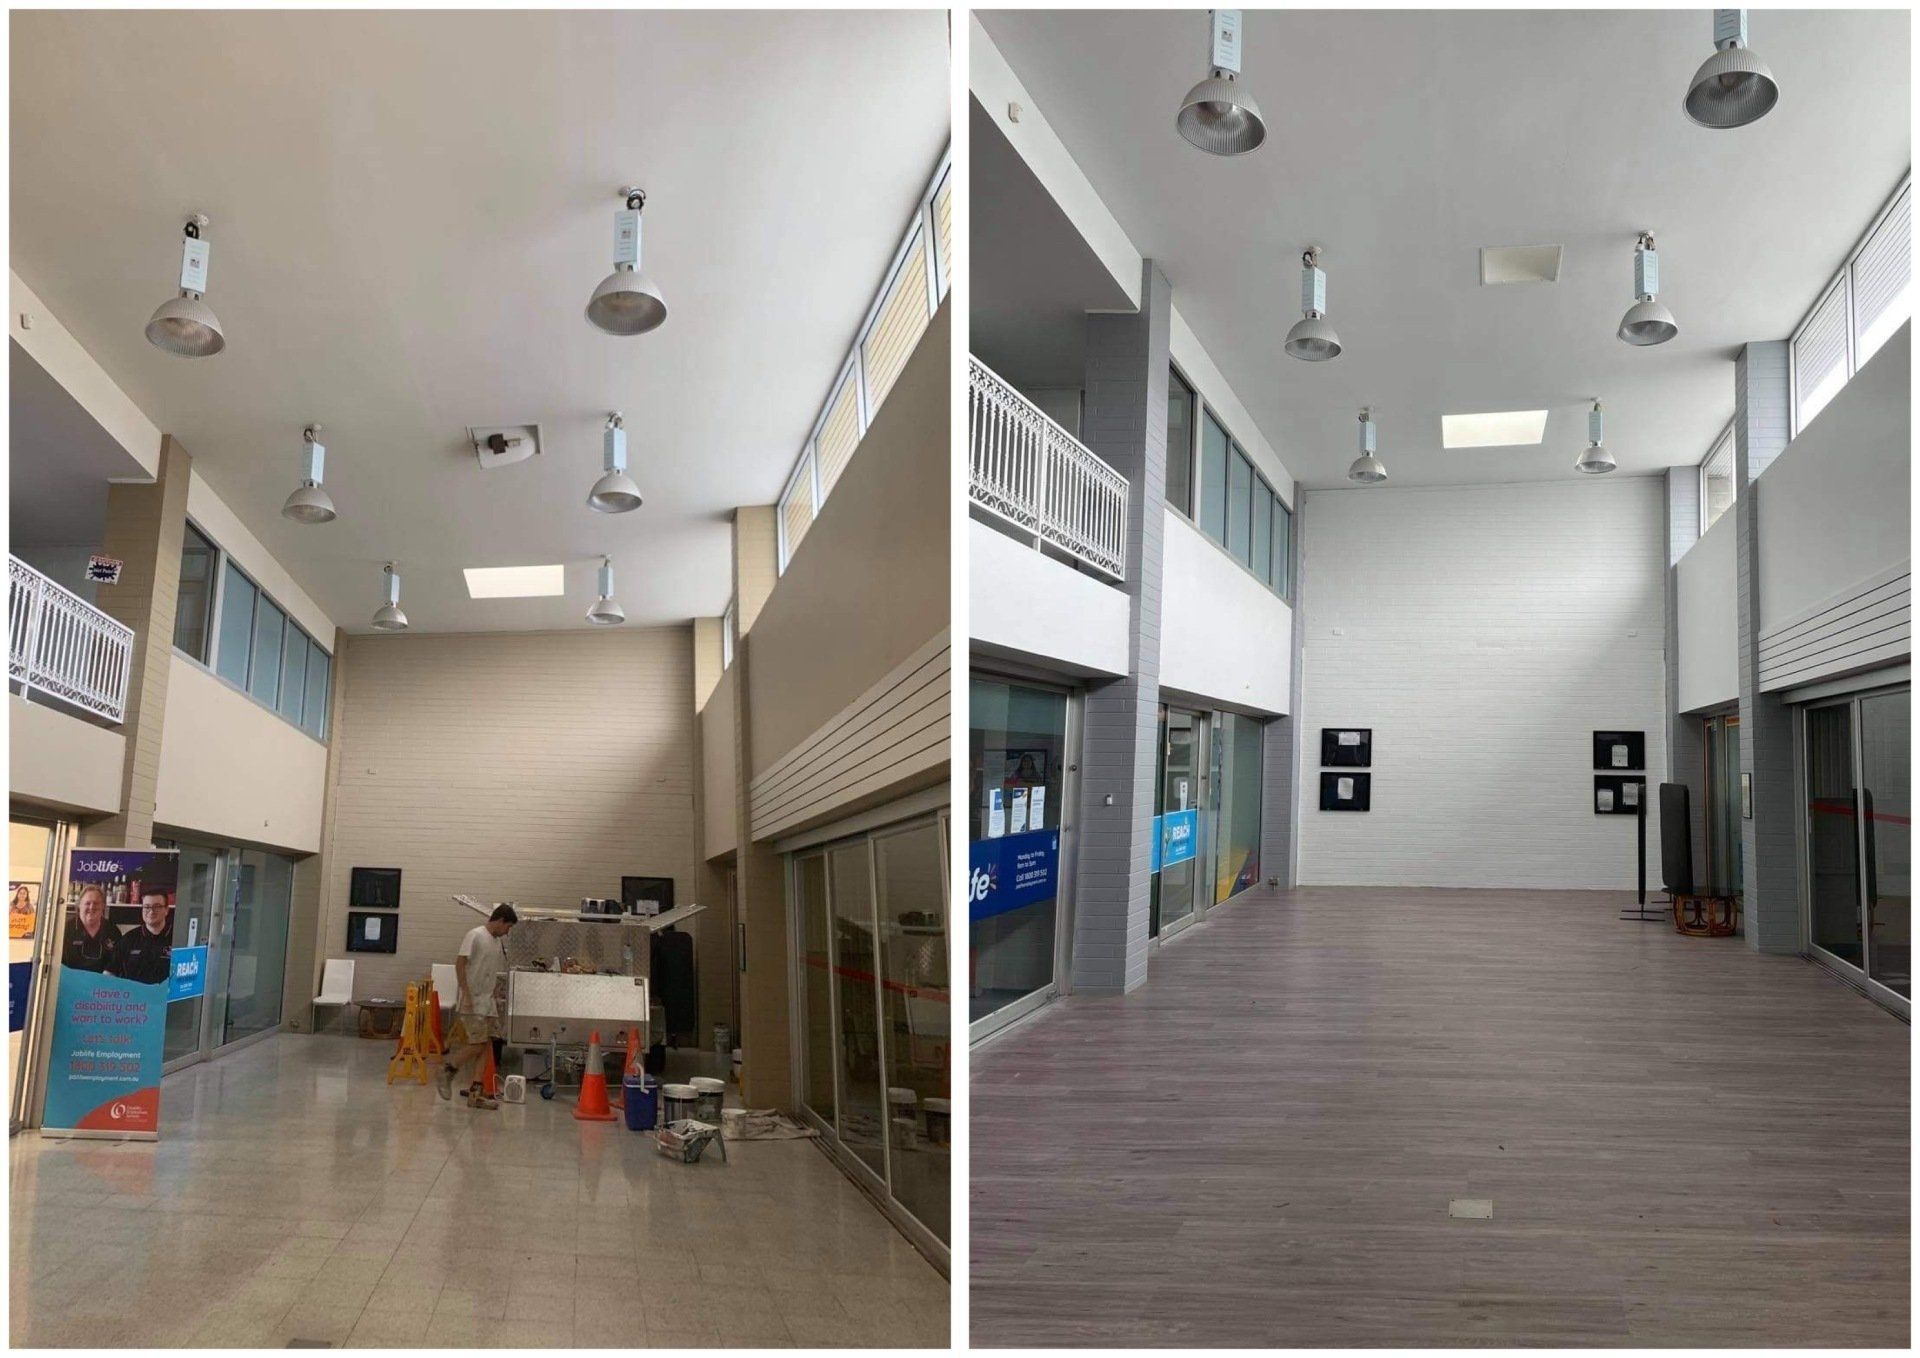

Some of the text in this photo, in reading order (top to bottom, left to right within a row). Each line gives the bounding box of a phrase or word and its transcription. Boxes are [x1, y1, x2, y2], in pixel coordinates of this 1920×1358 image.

[1172, 825, 1190, 840] REACH
[77, 860, 119, 872] Joblife
[969, 867, 990, 903] fe
[177, 962, 199, 976] REACH
[93, 989, 130, 999] Have a
[75, 1001, 146, 1014] disability and
[72, 1014, 148, 1025] want to work?
[97, 1050, 141, 1060] Employment
